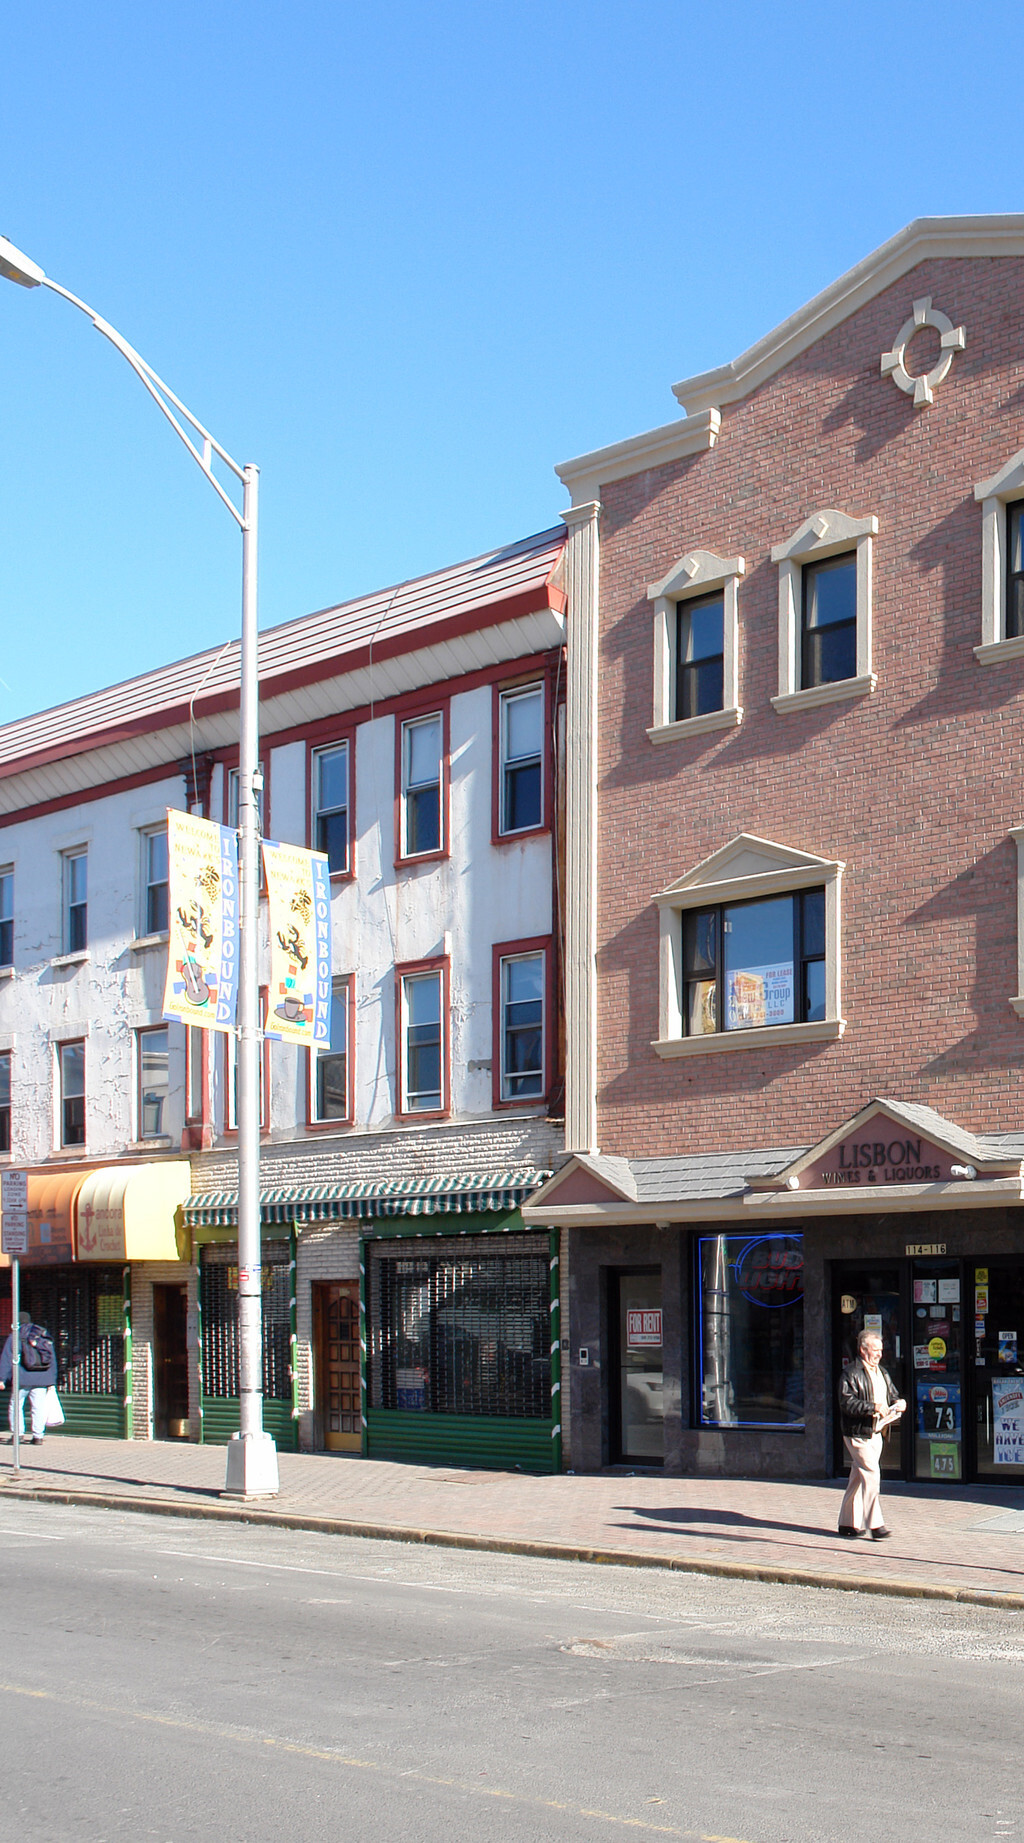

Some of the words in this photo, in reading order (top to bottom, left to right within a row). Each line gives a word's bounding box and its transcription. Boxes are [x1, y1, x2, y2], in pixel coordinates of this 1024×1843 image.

[216, 838, 236, 1021] IRONBOUND
[315, 862, 329, 1039] IRONBOUND
[766, 971, 777, 979] FOR
[777, 968, 792, 976] LEASE
[839, 1140, 921, 1168] LISBON
[822, 1171, 860, 1184] WINES
[868, 1171, 876, 1182] &
[884, 1165, 940, 1181] LIQUORS
[751, 1249, 804, 1270] BUD
[907, 1246, 946, 1255] 114-116
[842, 1299, 855, 1308] ATM
[629, 1313, 641, 1332] FOR
[643, 1312, 660, 1332] RENT
[935, 1407, 955, 1430] 73
[1001, 1419, 1020, 1431] WE
[998, 1449, 1024, 1463] ICE
